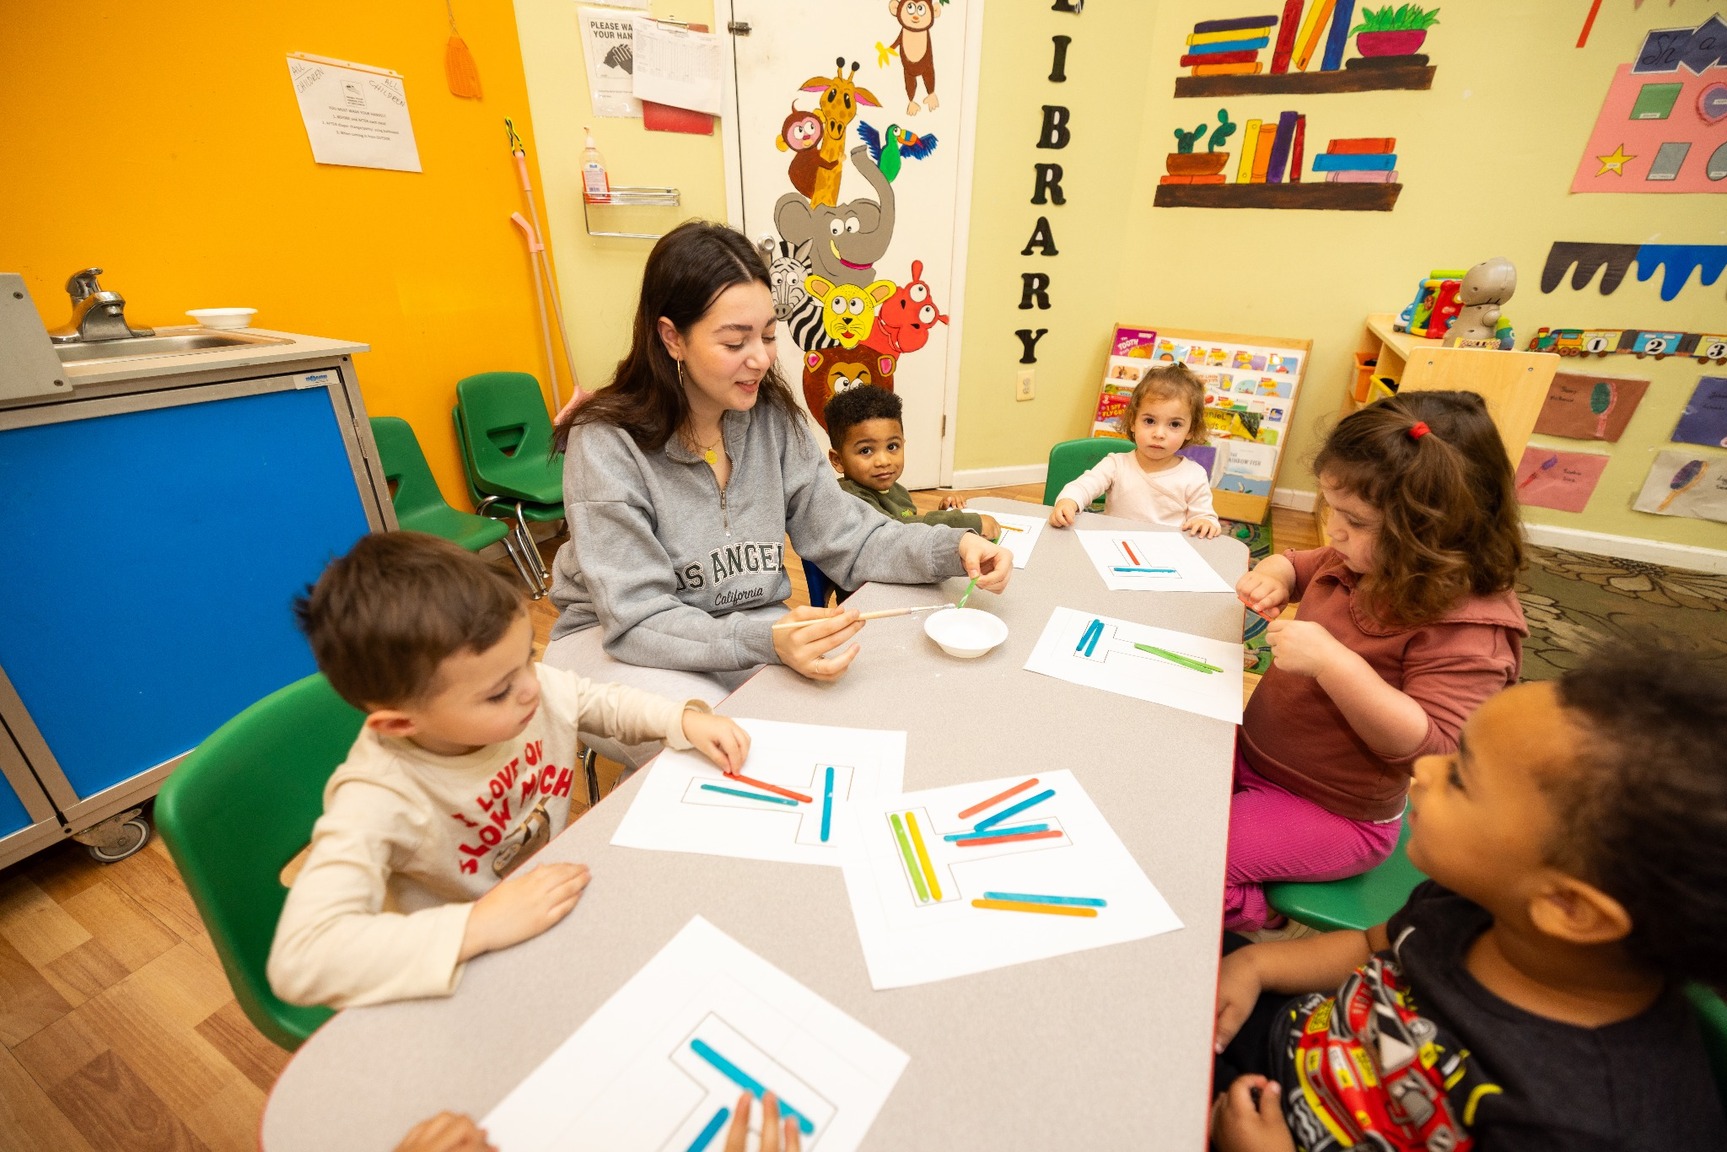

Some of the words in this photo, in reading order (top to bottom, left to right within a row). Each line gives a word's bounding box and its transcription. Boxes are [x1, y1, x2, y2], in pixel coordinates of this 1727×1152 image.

[590, 21, 619, 30] PLEASE
[621, 23, 633, 31] WA
[593, 30, 615, 38] YOUR
[617, 31, 633, 40] HAN
[1642, 34, 1717, 65] Sha
[291, 63, 306, 75] ALL
[296, 67, 325, 94] CHILDREN
[384, 79, 399, 91] ALL
[369, 80, 406, 107] CHILDREN
[1015, 0, 1085, 364] IBRARY
[1593, 339, 1602, 350] 1
[1650, 340, 1663, 353] 2
[1711, 344, 1725, 357] 3
[714, 586, 764, 606] California
[475, 757, 519, 813] LOVE
[459, 797, 512, 876] SLOW
